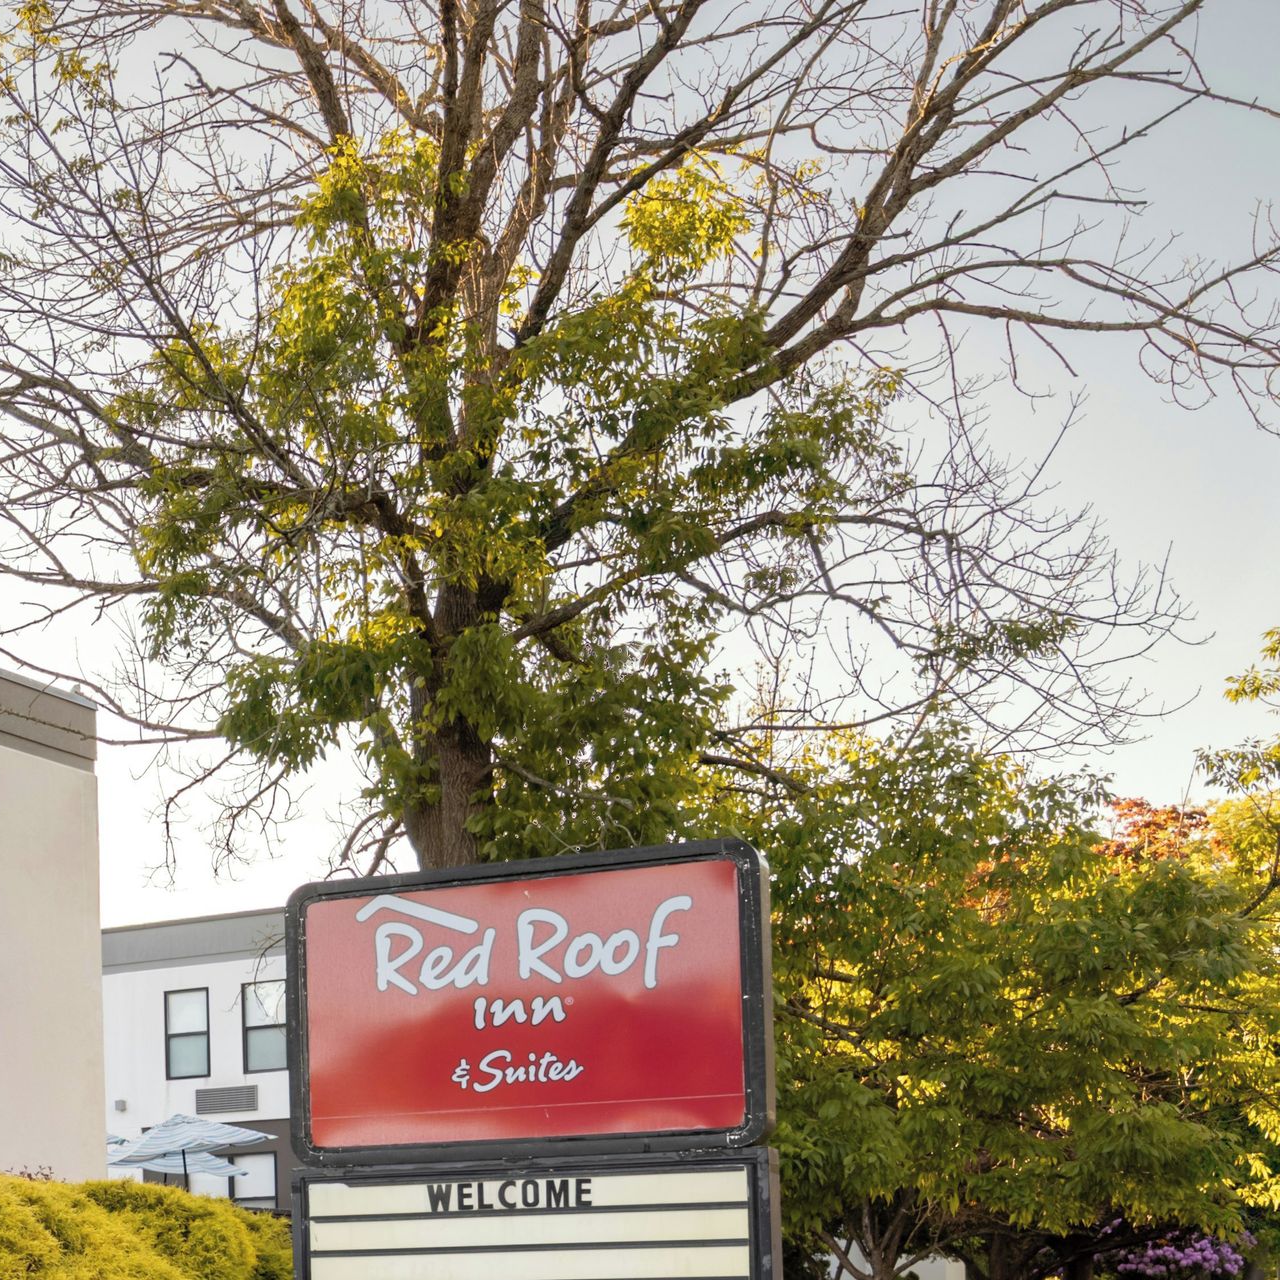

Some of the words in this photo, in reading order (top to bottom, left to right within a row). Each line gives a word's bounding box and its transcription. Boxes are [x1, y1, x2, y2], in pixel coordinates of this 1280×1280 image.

[375, 921, 496, 995] Red
[517, 895, 692, 989] Roof
[451, 1058, 470, 1089] &
[473, 1049, 584, 1093] Suites
[427, 1178, 592, 1212] WELCOME
